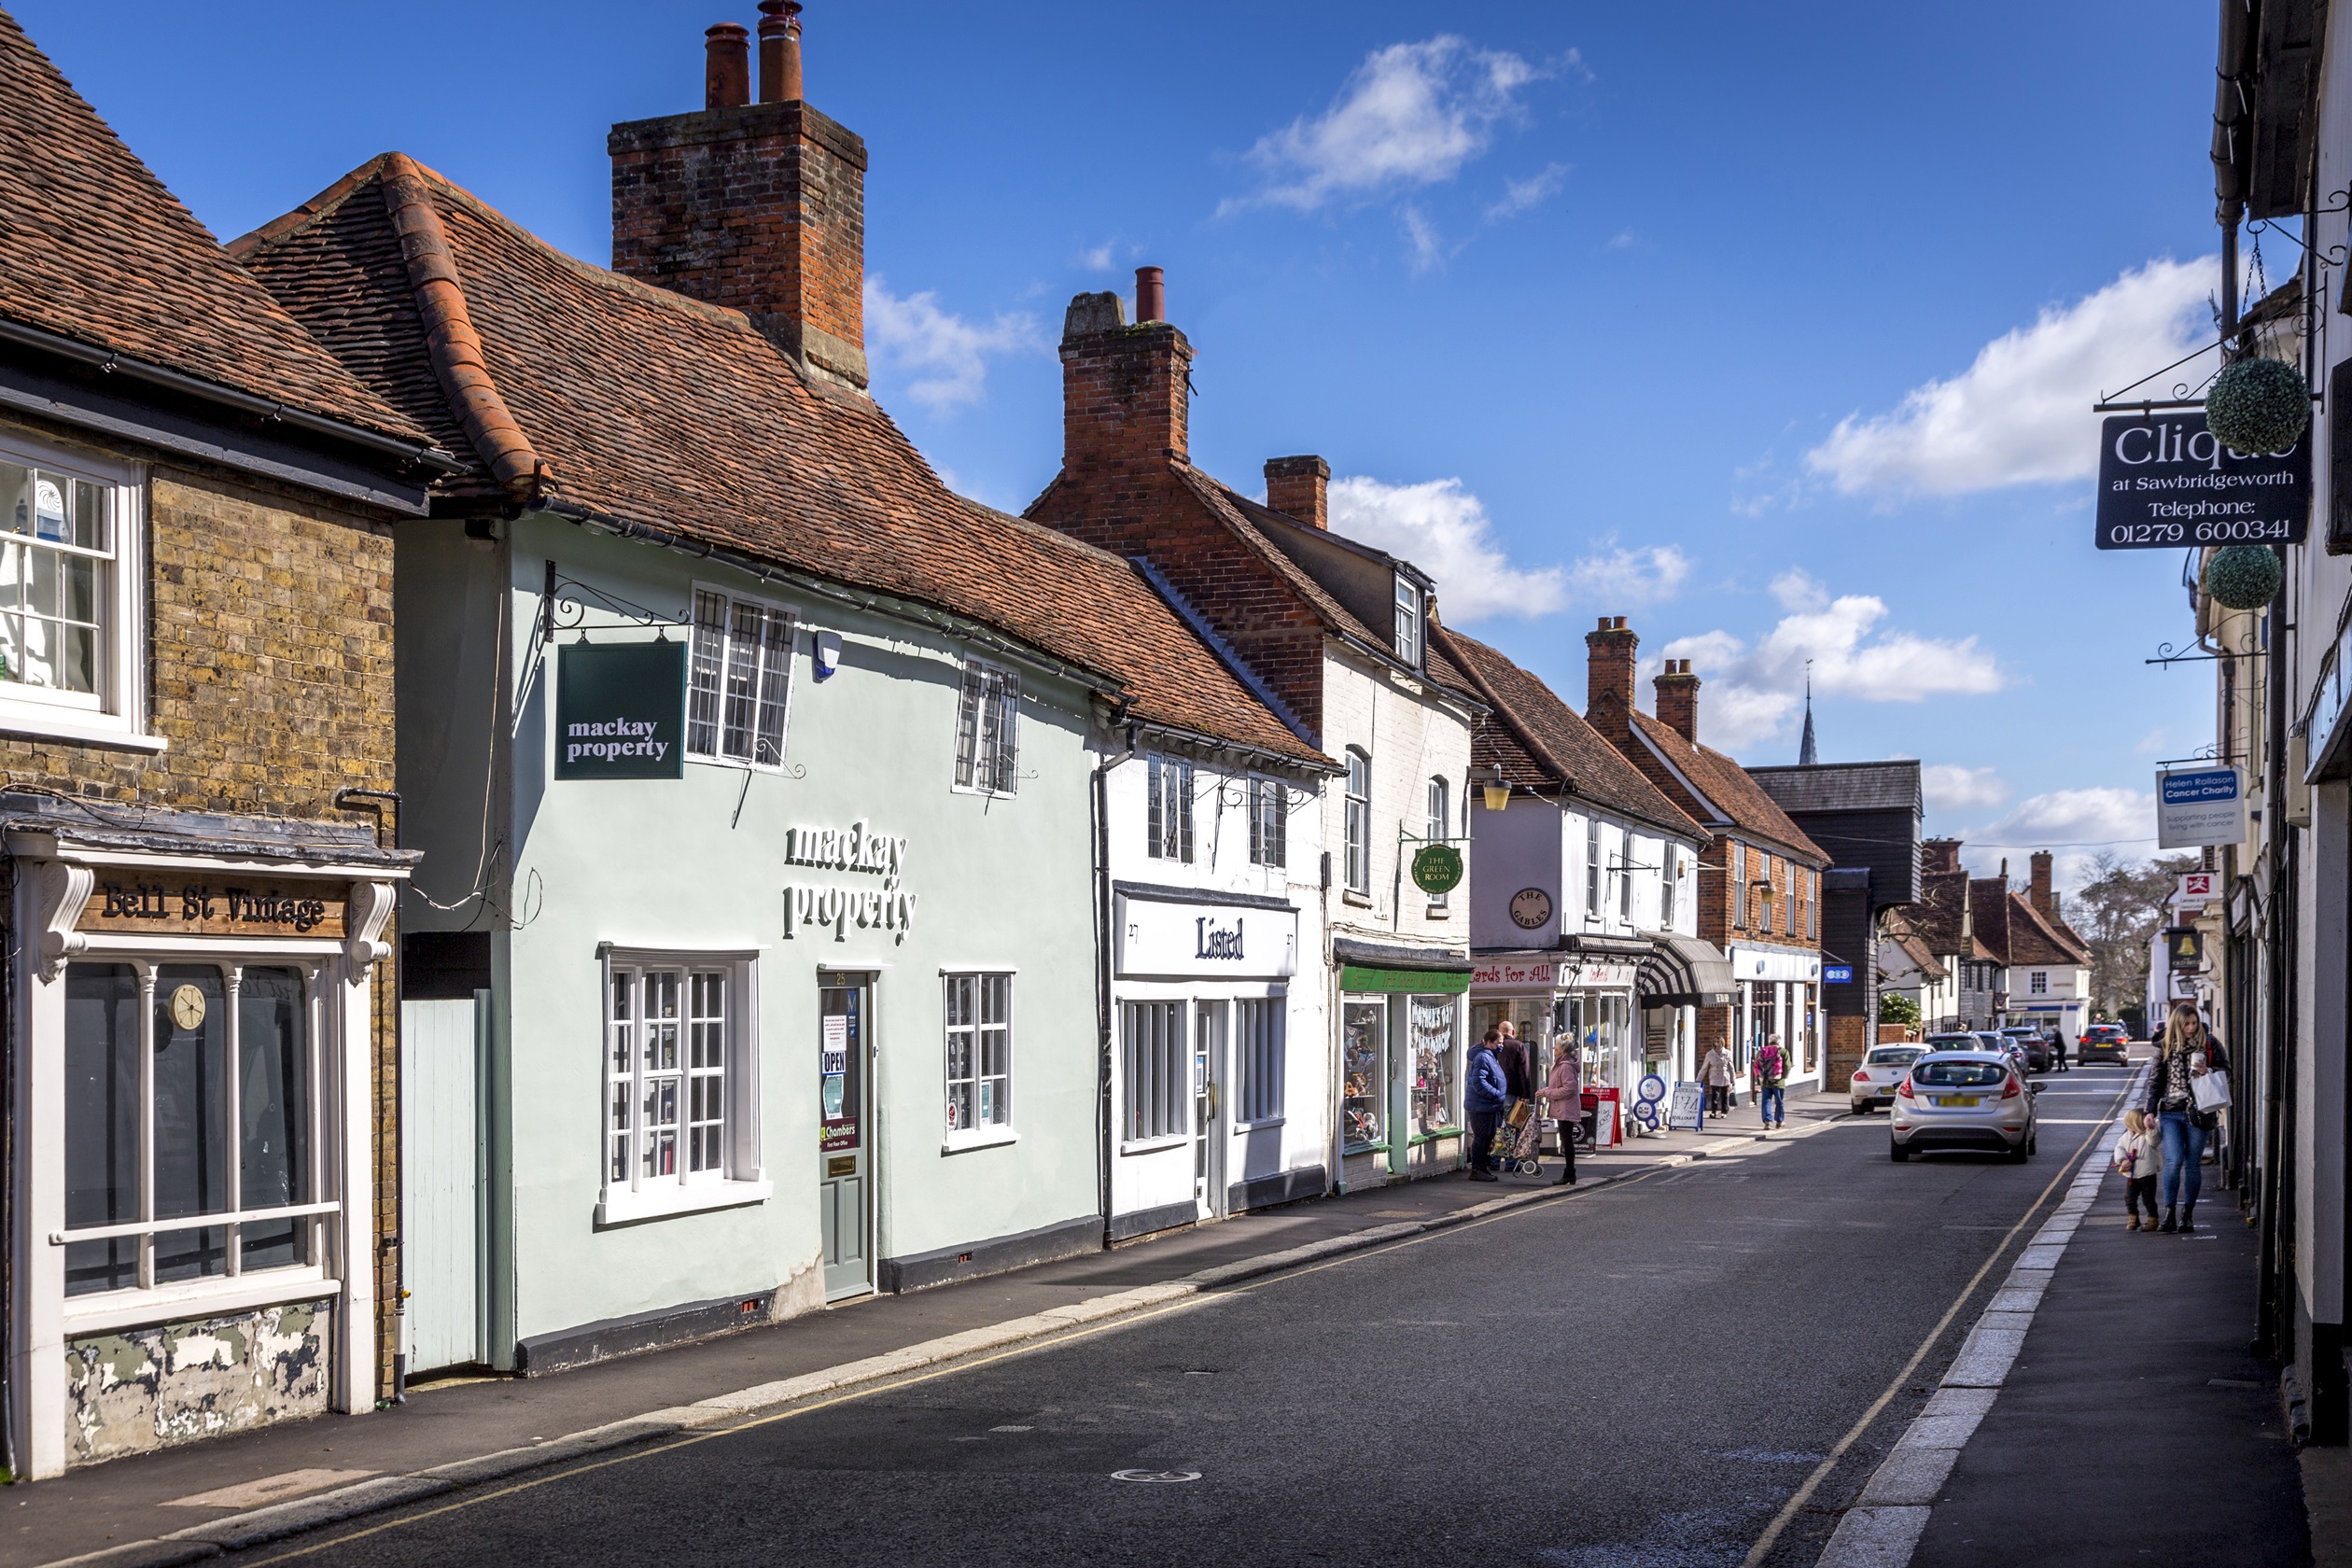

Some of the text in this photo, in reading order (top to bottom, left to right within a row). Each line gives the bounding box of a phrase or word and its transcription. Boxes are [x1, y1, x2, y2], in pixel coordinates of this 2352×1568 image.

[2115, 423, 2298, 470] Cliq
[2112, 470, 2294, 491] at Sawbridgeworth
[2148, 499, 2256, 520] Telephone:
[2110, 519, 2290, 543] 01279 600341
[567, 717, 658, 742] mackay
[567, 737, 669, 763] property
[2165, 777, 2234, 789] Helen Rollason
[2165, 786, 2234, 799] Cancer Charity
[2166, 810, 2236, 823] Supporting people
[2168, 819, 2234, 832] living with cancer
[785, 818, 910, 889] mackay
[101, 881, 325, 931] Bell St Vintage
[1518, 891, 1543, 902] THE
[784, 882, 919, 943] property
[1514, 909, 1547, 925] GABLES
[1128, 924, 1139, 945] 27
[1195, 917, 1245, 960] Listed
[836, 973, 846, 986] 25
[1382, 971, 1397, 987] THE
[1397, 971, 1419, 987] GREEN
[1419, 972, 1438, 988] ROOM
[1469, 965, 1500, 983] Cards
[1505, 966, 1525, 982] for
[1529, 964, 1550, 983] All
[824, 1051, 845, 1072] OPEN
[826, 1124, 856, 1138] Chambers
